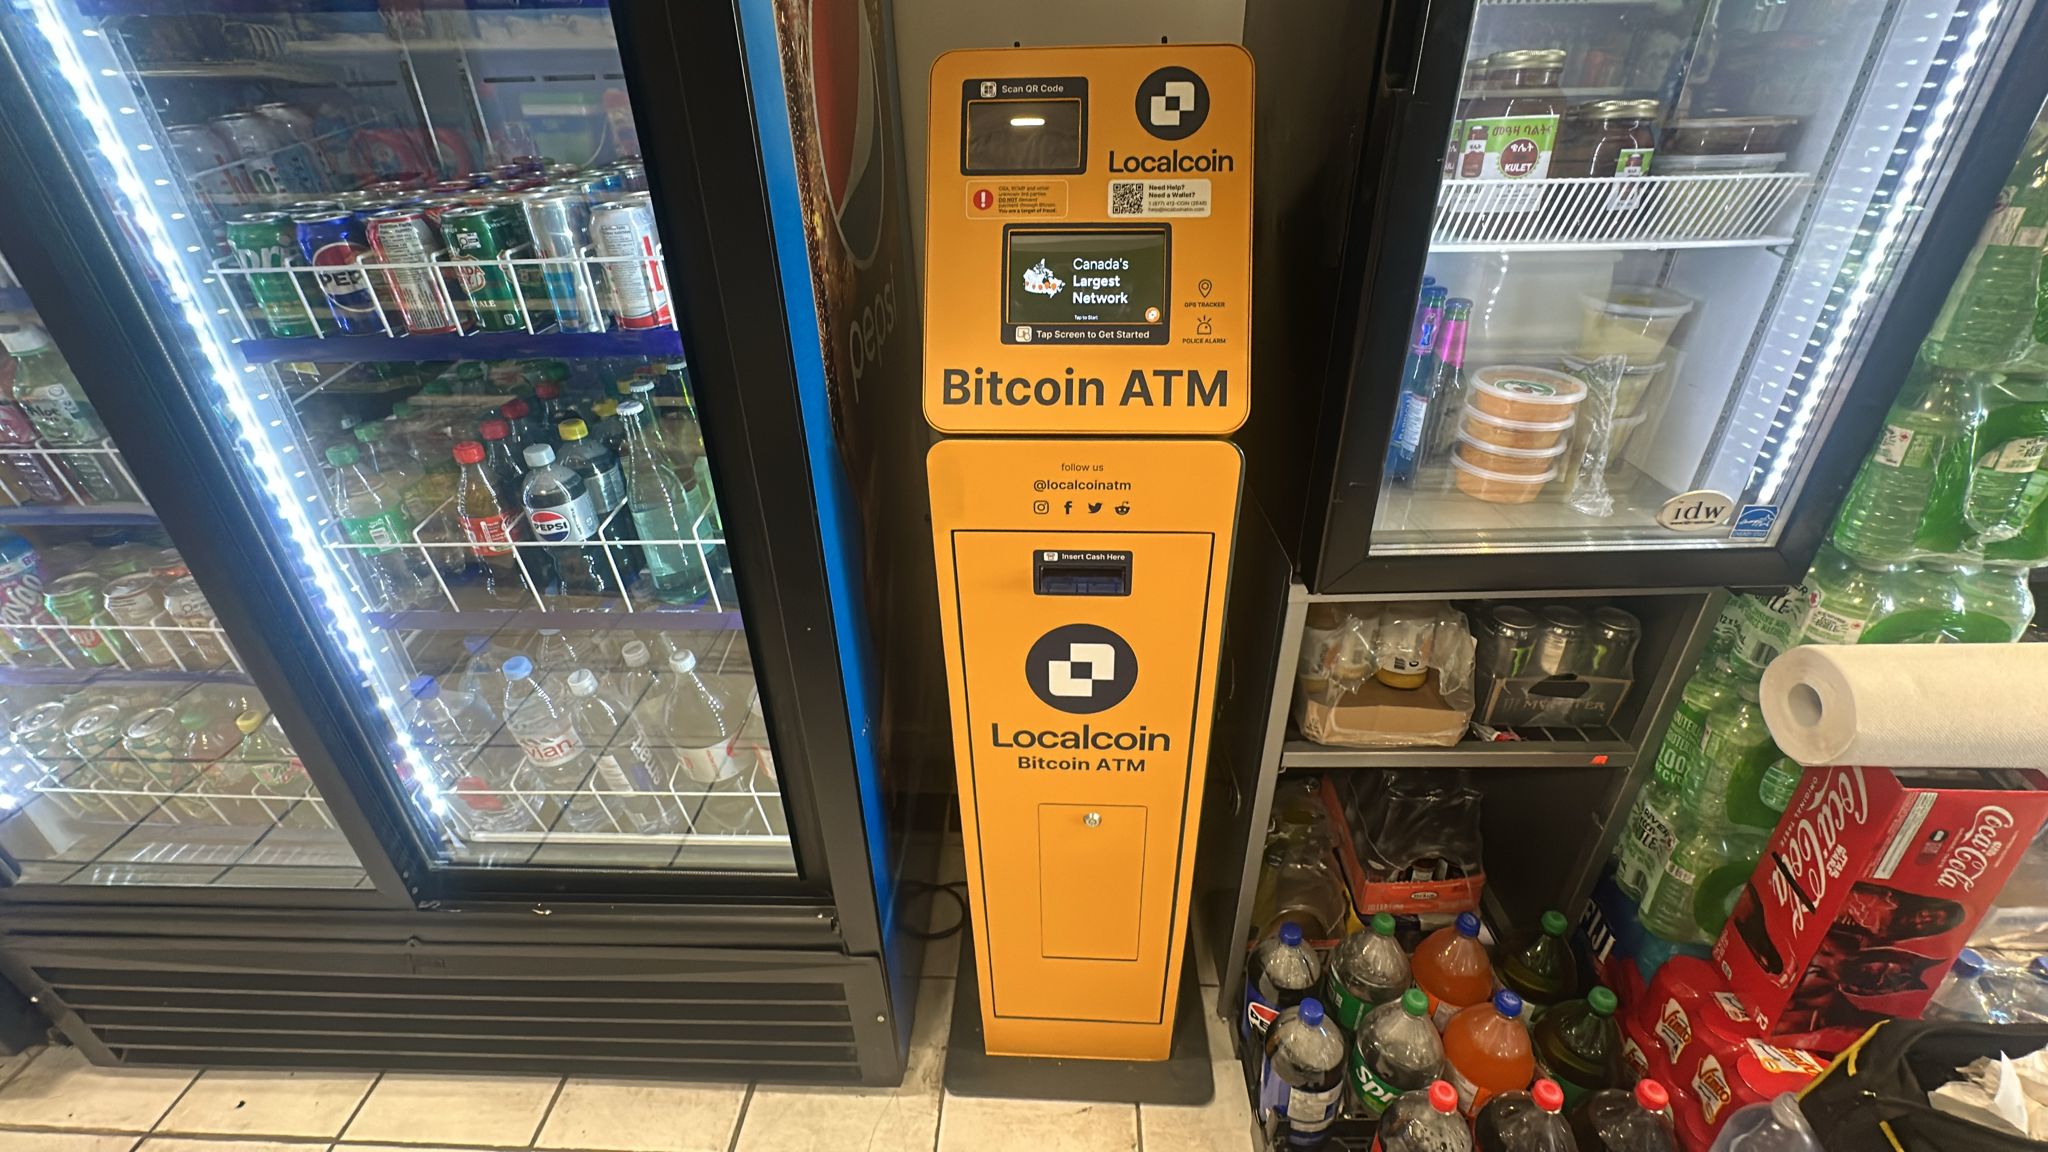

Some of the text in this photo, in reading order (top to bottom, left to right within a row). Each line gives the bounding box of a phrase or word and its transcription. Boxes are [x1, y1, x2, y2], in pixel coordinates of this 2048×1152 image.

[1001, 84, 1064, 93] Scan QR Code
[1108, 148, 1234, 172] Localcoin
[1504, 163, 1533, 172] KULET
[1072, 257, 1129, 271] Canada's
[1072, 274, 1121, 289] Largest
[1072, 291, 1129, 304] Network
[848, 264, 898, 405] pepsi
[1036, 329, 1150, 340] Tap Screen to Get Started
[942, 366, 1229, 407] Bitcoin ATM
[1061, 462, 1104, 472] follow us
[1033, 479, 1132, 492] @localcoinatm
[1674, 500, 1726, 520] idw
[533, 521, 569, 532] PEPSI
[1106, 553, 1126, 561] Here
[990, 722, 1171, 752] Localcoin
[1017, 755, 1146, 772] Bitcoin ATM
[1772, 765, 1869, 939] Coca-Cola
[1938, 805, 2015, 893] Coca-Cola
[1579, 898, 1617, 965] FIJI
